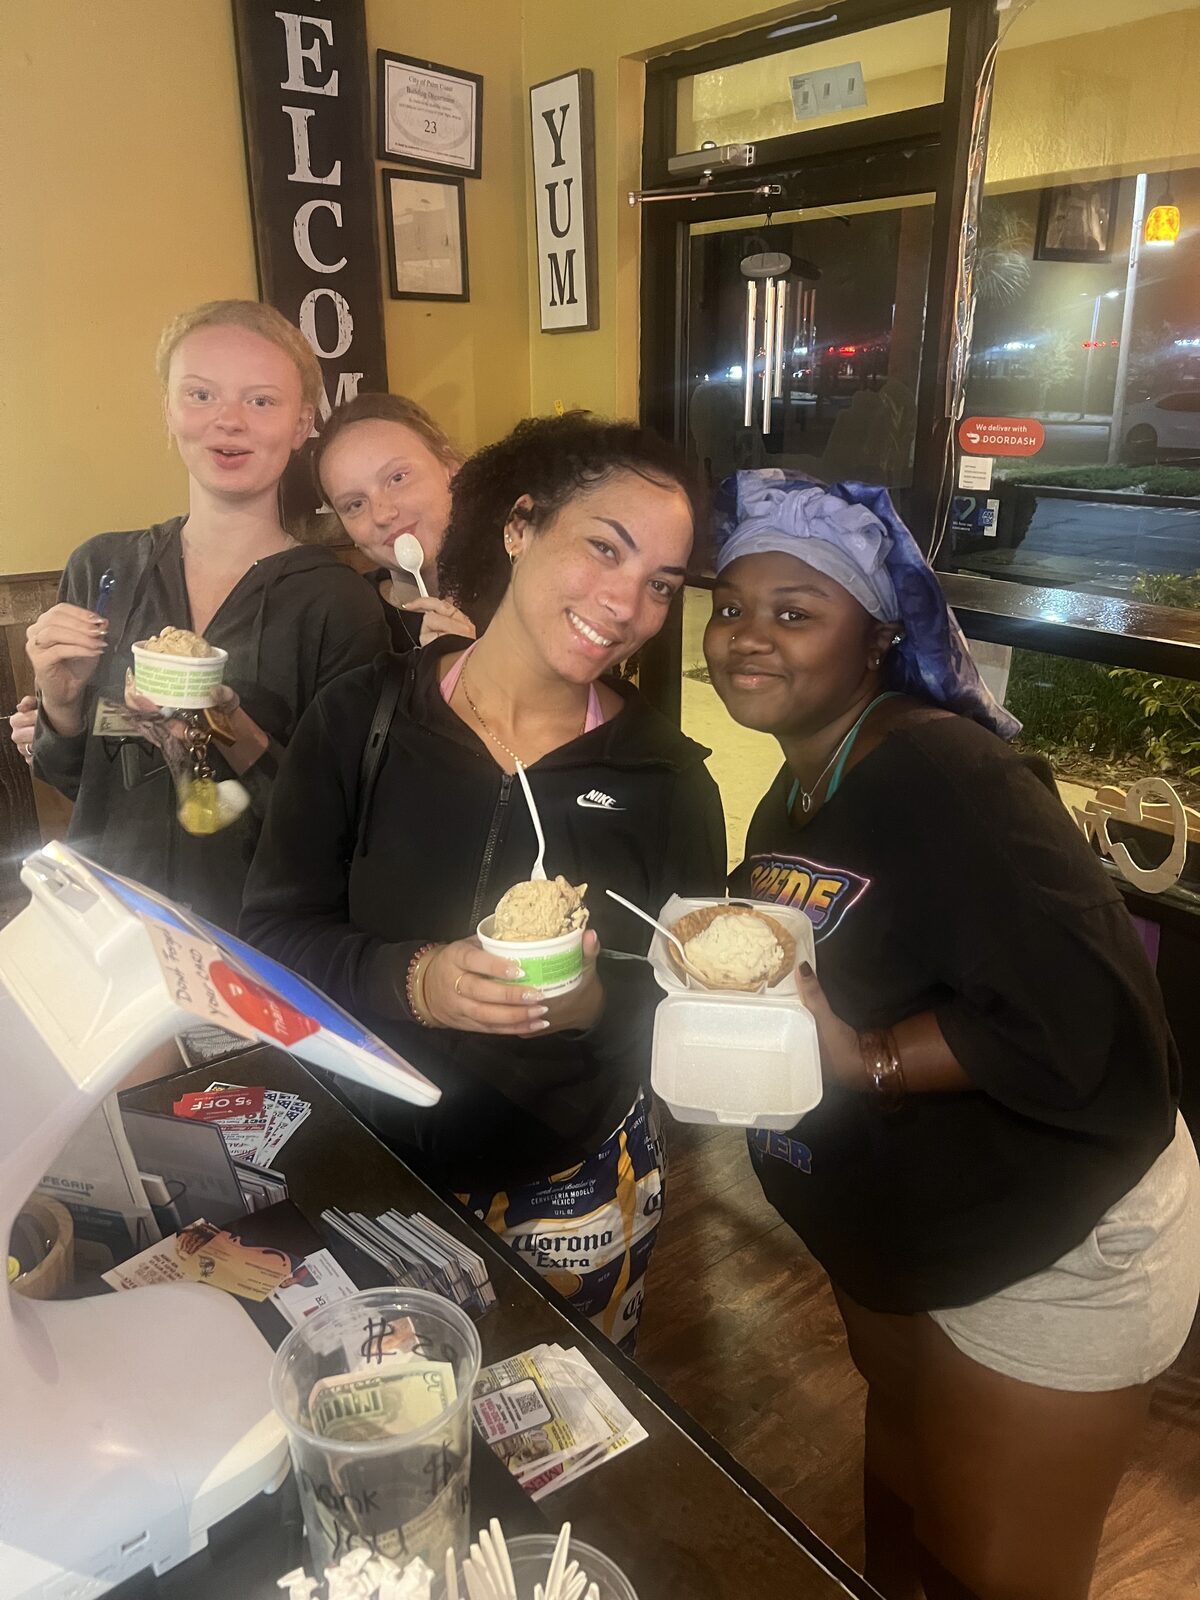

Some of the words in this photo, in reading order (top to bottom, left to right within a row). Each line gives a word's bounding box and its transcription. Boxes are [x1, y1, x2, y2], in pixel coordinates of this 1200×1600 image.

[424, 119, 437, 134] 23
[542, 104, 578, 307] YUM
[975, 423, 987, 431] We
[987, 424, 1011, 432] deliver
[1012, 425, 1027, 433] with
[982, 435, 1036, 446] DOORDASH
[586, 789, 617, 807] NIKE
[190, 1098, 230, 1111] OFF
[235, 1096, 252, 1106] $5
[570, 1187, 594, 1199] MODELO
[511, 1230, 613, 1257] Corona
[536, 1252, 590, 1268] Extra
